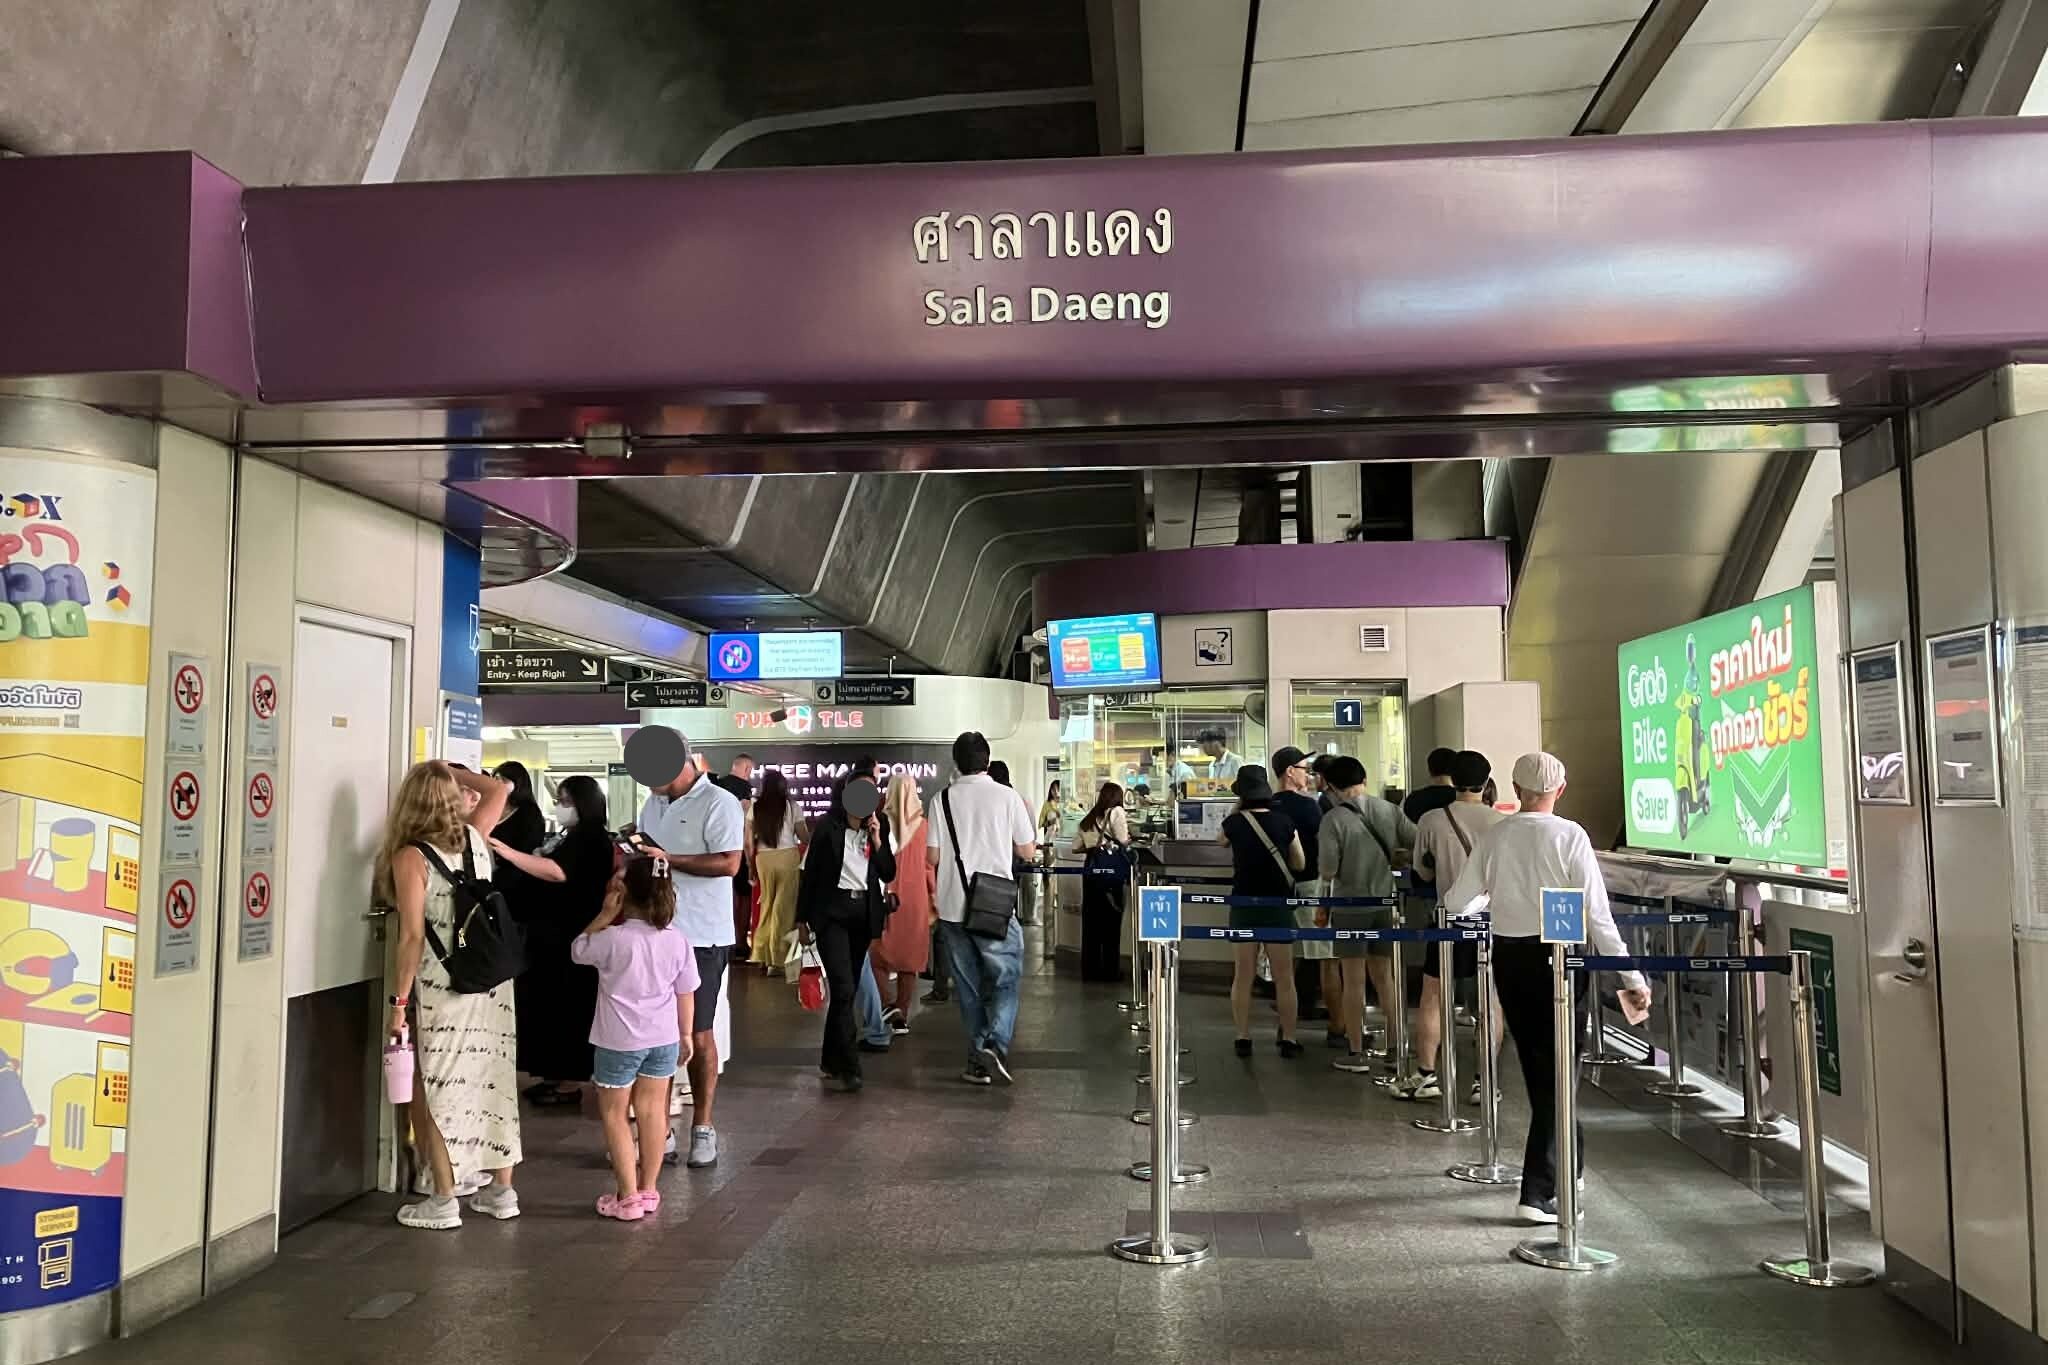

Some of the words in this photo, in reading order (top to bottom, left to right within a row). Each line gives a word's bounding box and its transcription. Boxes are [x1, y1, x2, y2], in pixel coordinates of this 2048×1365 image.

[912, 207, 1173, 262] ศาลาแดง
[924, 286, 1013, 326] Sala
[1029, 286, 1170, 329] Daeng
[1710, 604, 1793, 696] ราคาใหม่
[487, 655, 505, 667] เข้า
[487, 670, 510, 680] Entry
[518, 670, 540, 680] Keep
[542, 669, 565, 680] Right
[1628, 656, 1667, 708] Grab
[1342, 705, 1353, 722] 1
[1632, 717, 1668, 764] Bike
[877, 763, 937, 778] DOWN
[1637, 788, 1669, 821] Saver
[1191, 895, 1225, 903] BTS
[1152, 917, 1168, 929] IN
[1668, 913, 1709, 923] BTS
[1554, 919, 1571, 931] IN
[1210, 928, 1254, 938] BTS
[1335, 930, 1380, 939] BTS
[1462, 930, 1489, 939] BT
[1689, 958, 1747, 969] BTS
